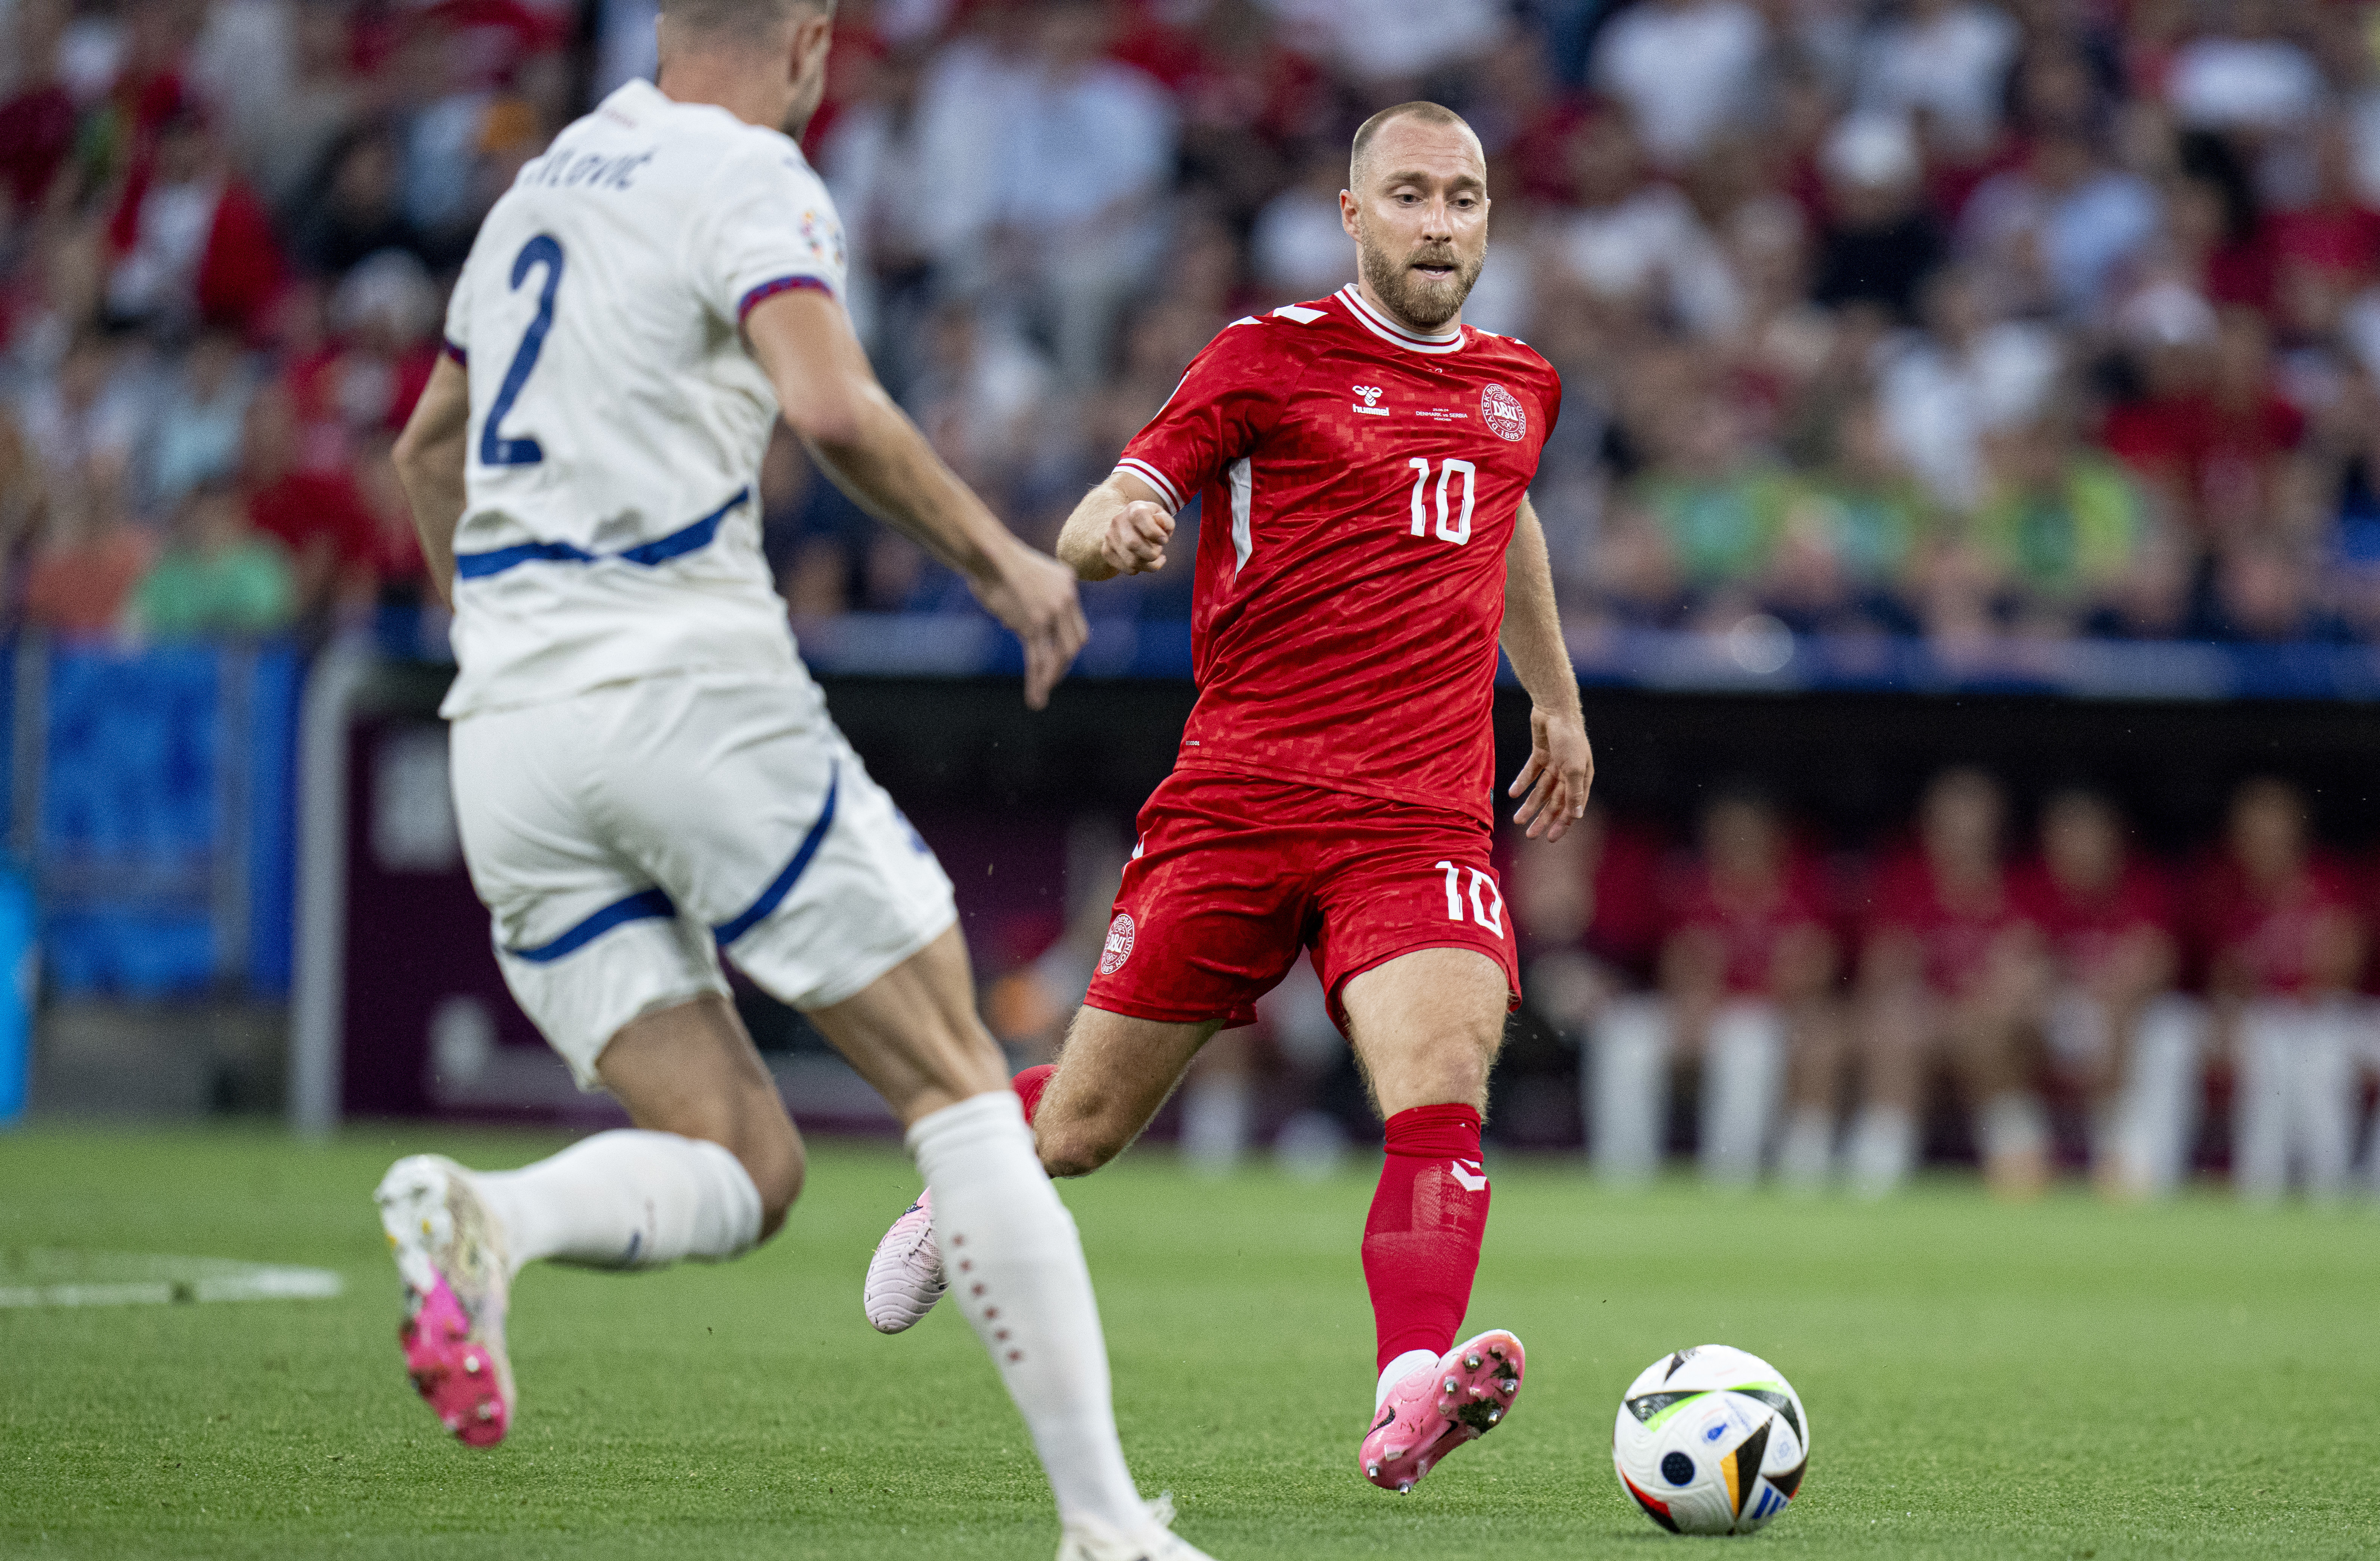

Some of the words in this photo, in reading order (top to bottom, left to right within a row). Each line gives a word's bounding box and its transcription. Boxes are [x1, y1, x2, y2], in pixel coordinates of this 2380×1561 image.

[480, 234, 565, 466] 2
[1352, 403, 1390, 416] hummel
[1483, 395, 1499, 430] DANSK
[1492, 400, 1519, 421] DBU
[1516, 406, 1525, 435] UNION
[1501, 430, 1519, 440] 1889
[1409, 458, 1476, 545] 10
[1435, 861, 1504, 939] 10
[1115, 936, 1133, 968] UNION
